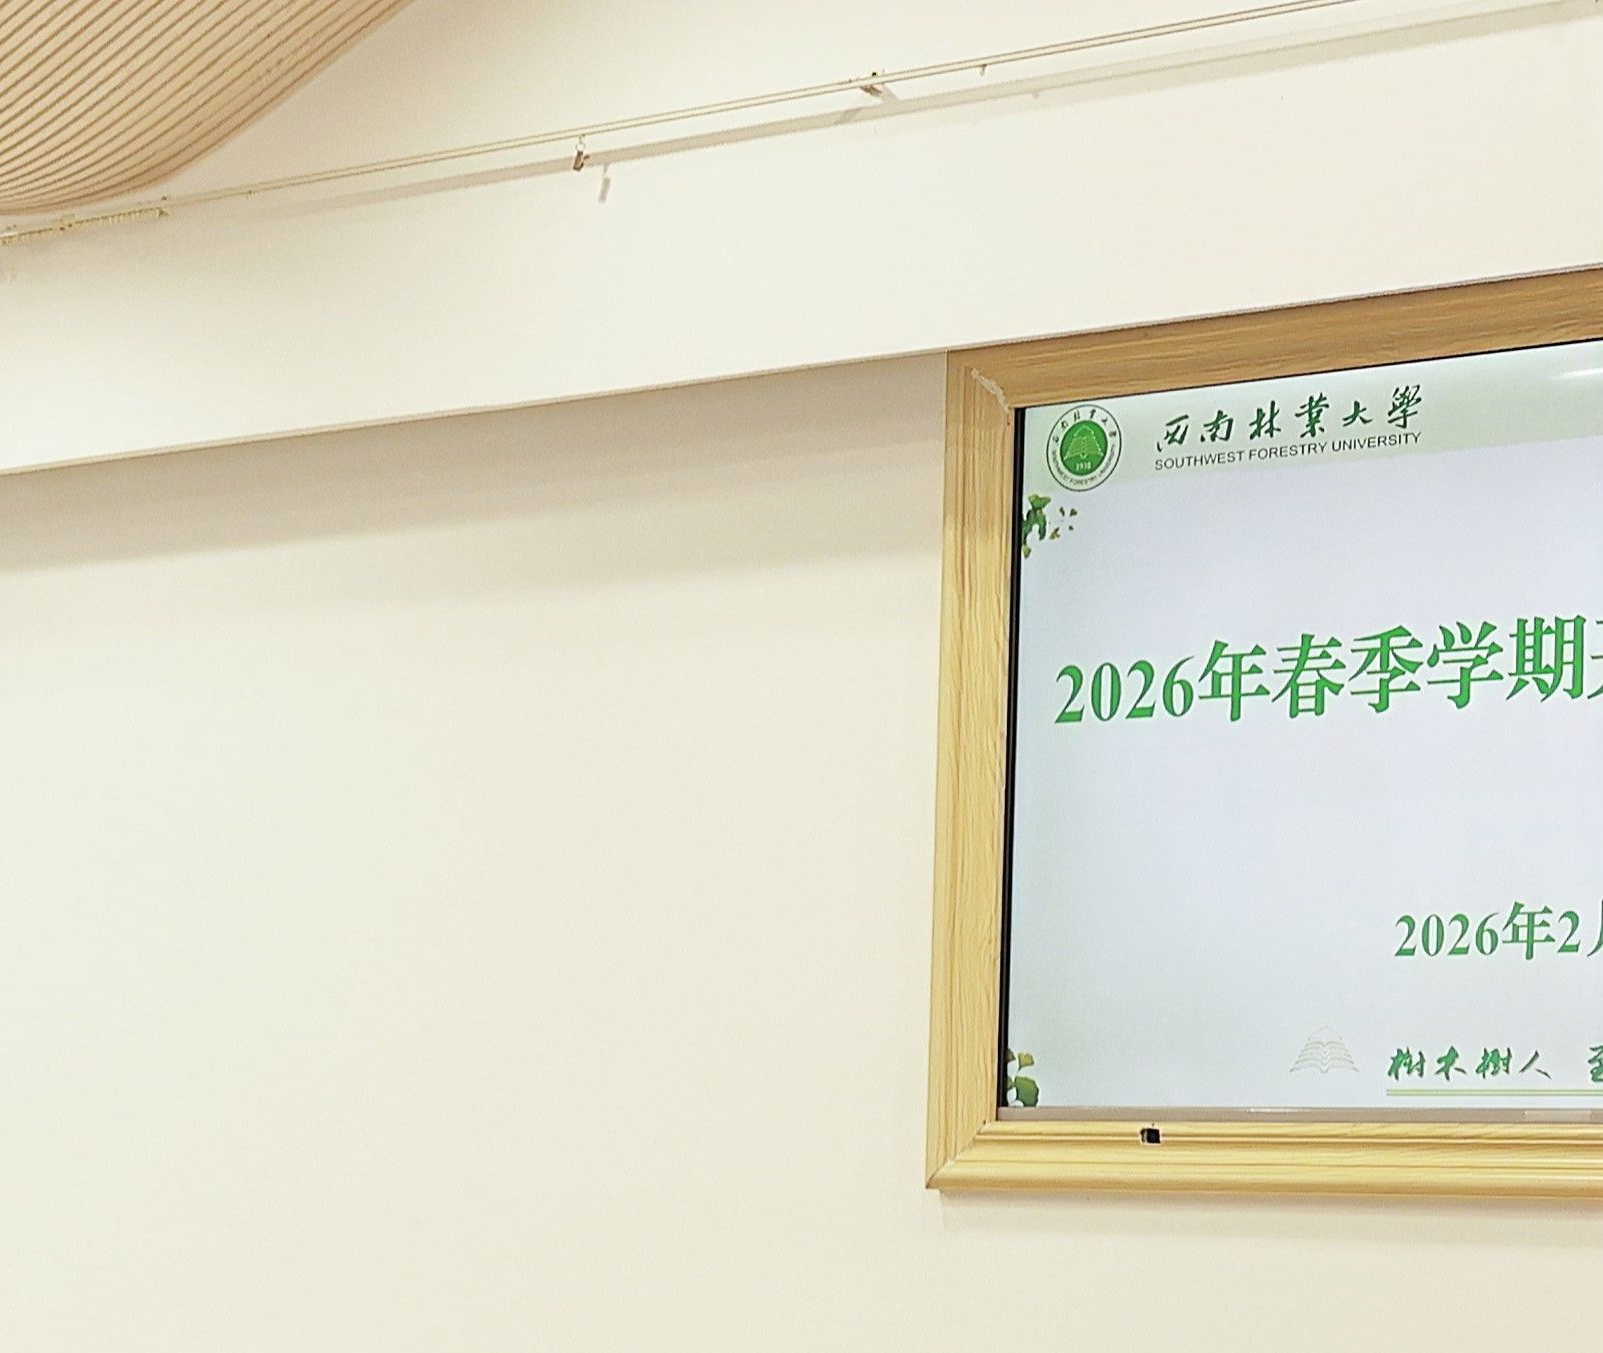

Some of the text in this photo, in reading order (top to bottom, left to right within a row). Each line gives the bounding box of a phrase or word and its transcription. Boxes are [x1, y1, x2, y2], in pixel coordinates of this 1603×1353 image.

[1155, 432, 1421, 471] SOUTHWEST FORESTRY UNIVERSITY
[1055, 615, 1603, 724] 2026年春季学期
